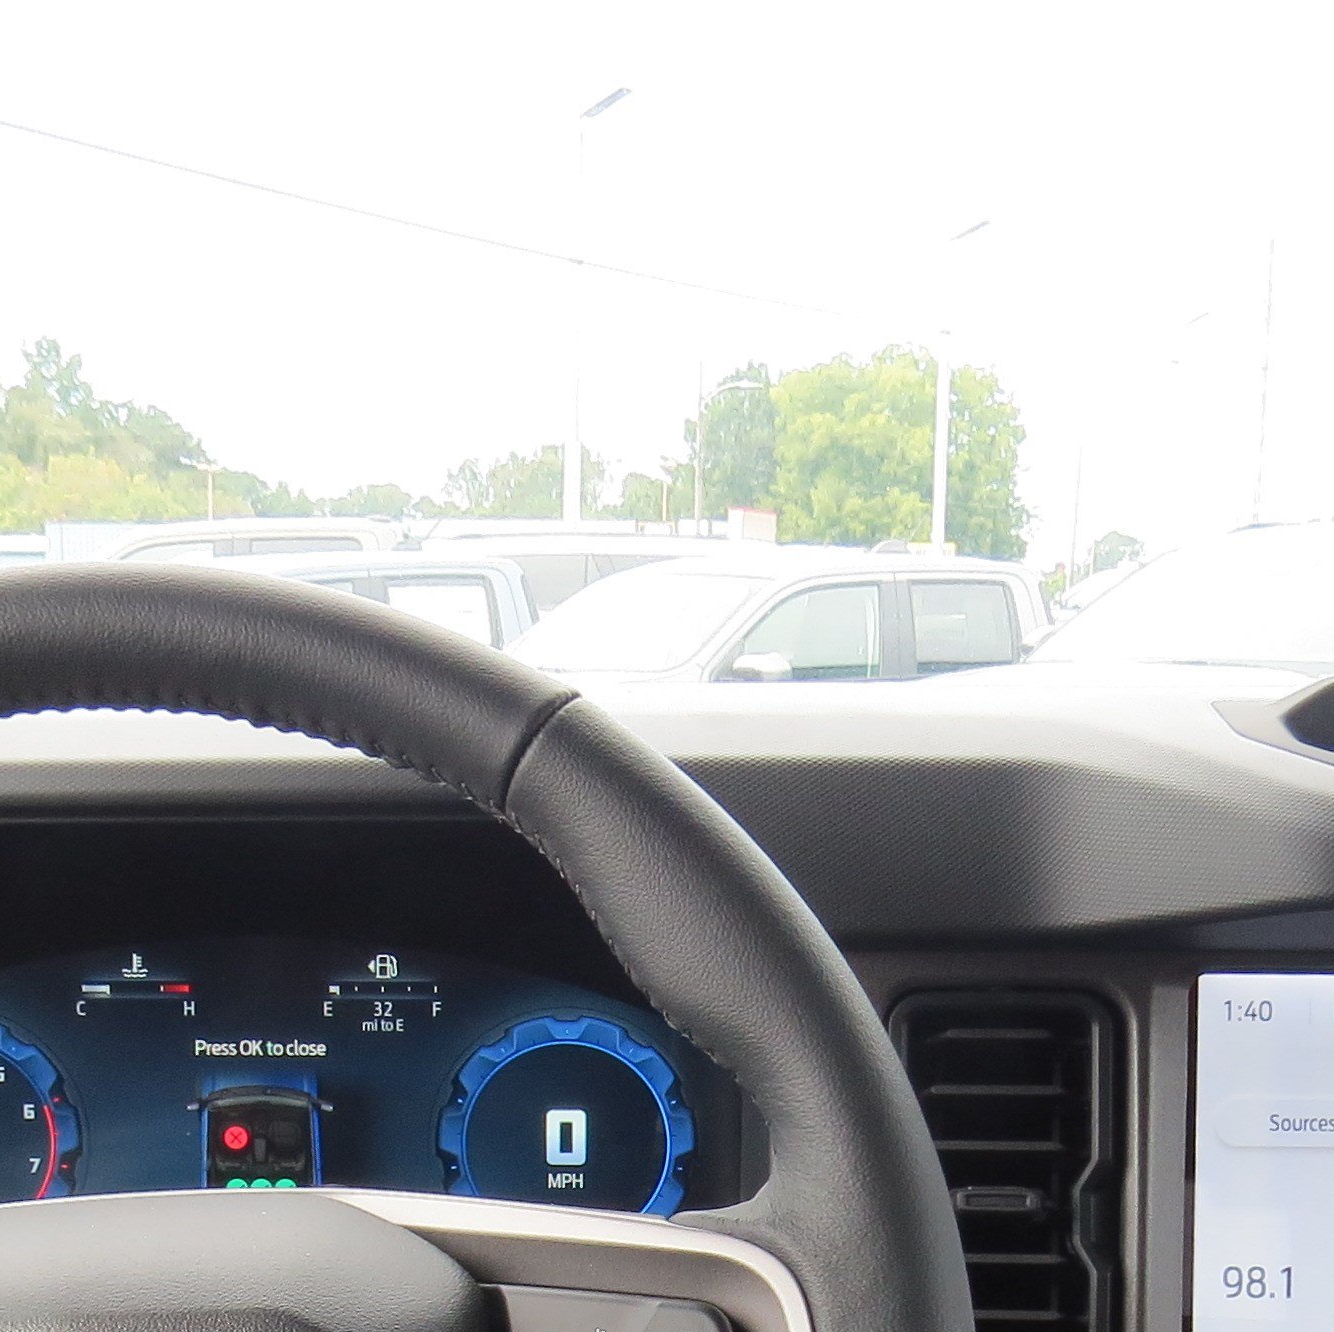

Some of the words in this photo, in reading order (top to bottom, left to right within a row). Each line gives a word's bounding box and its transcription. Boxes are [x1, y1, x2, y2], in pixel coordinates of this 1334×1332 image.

[76, 1001, 87, 1016] C
[183, 1001, 195, 1016] H
[323, 1001, 333, 1016] E
[373, 1002, 393, 1017] 32
[432, 1002, 442, 1017] F
[1223, 1000, 1274, 1022] 1:40
[362, 1020, 378, 1031] mi
[380, 1020, 394, 1031] to
[396, 1020, 404, 1031] E
[195, 1040, 237, 1056] Press
[240, 1040, 264, 1056] OK
[267, 1041, 284, 1056] to
[286, 1040, 327, 1056] close
[23, 1104, 35, 1120] 6
[545, 1109, 587, 1166] 0
[29, 1158, 41, 1173] 7
[548, 1173, 584, 1189] MPH
[1223, 1266, 1293, 1299] 98.1
